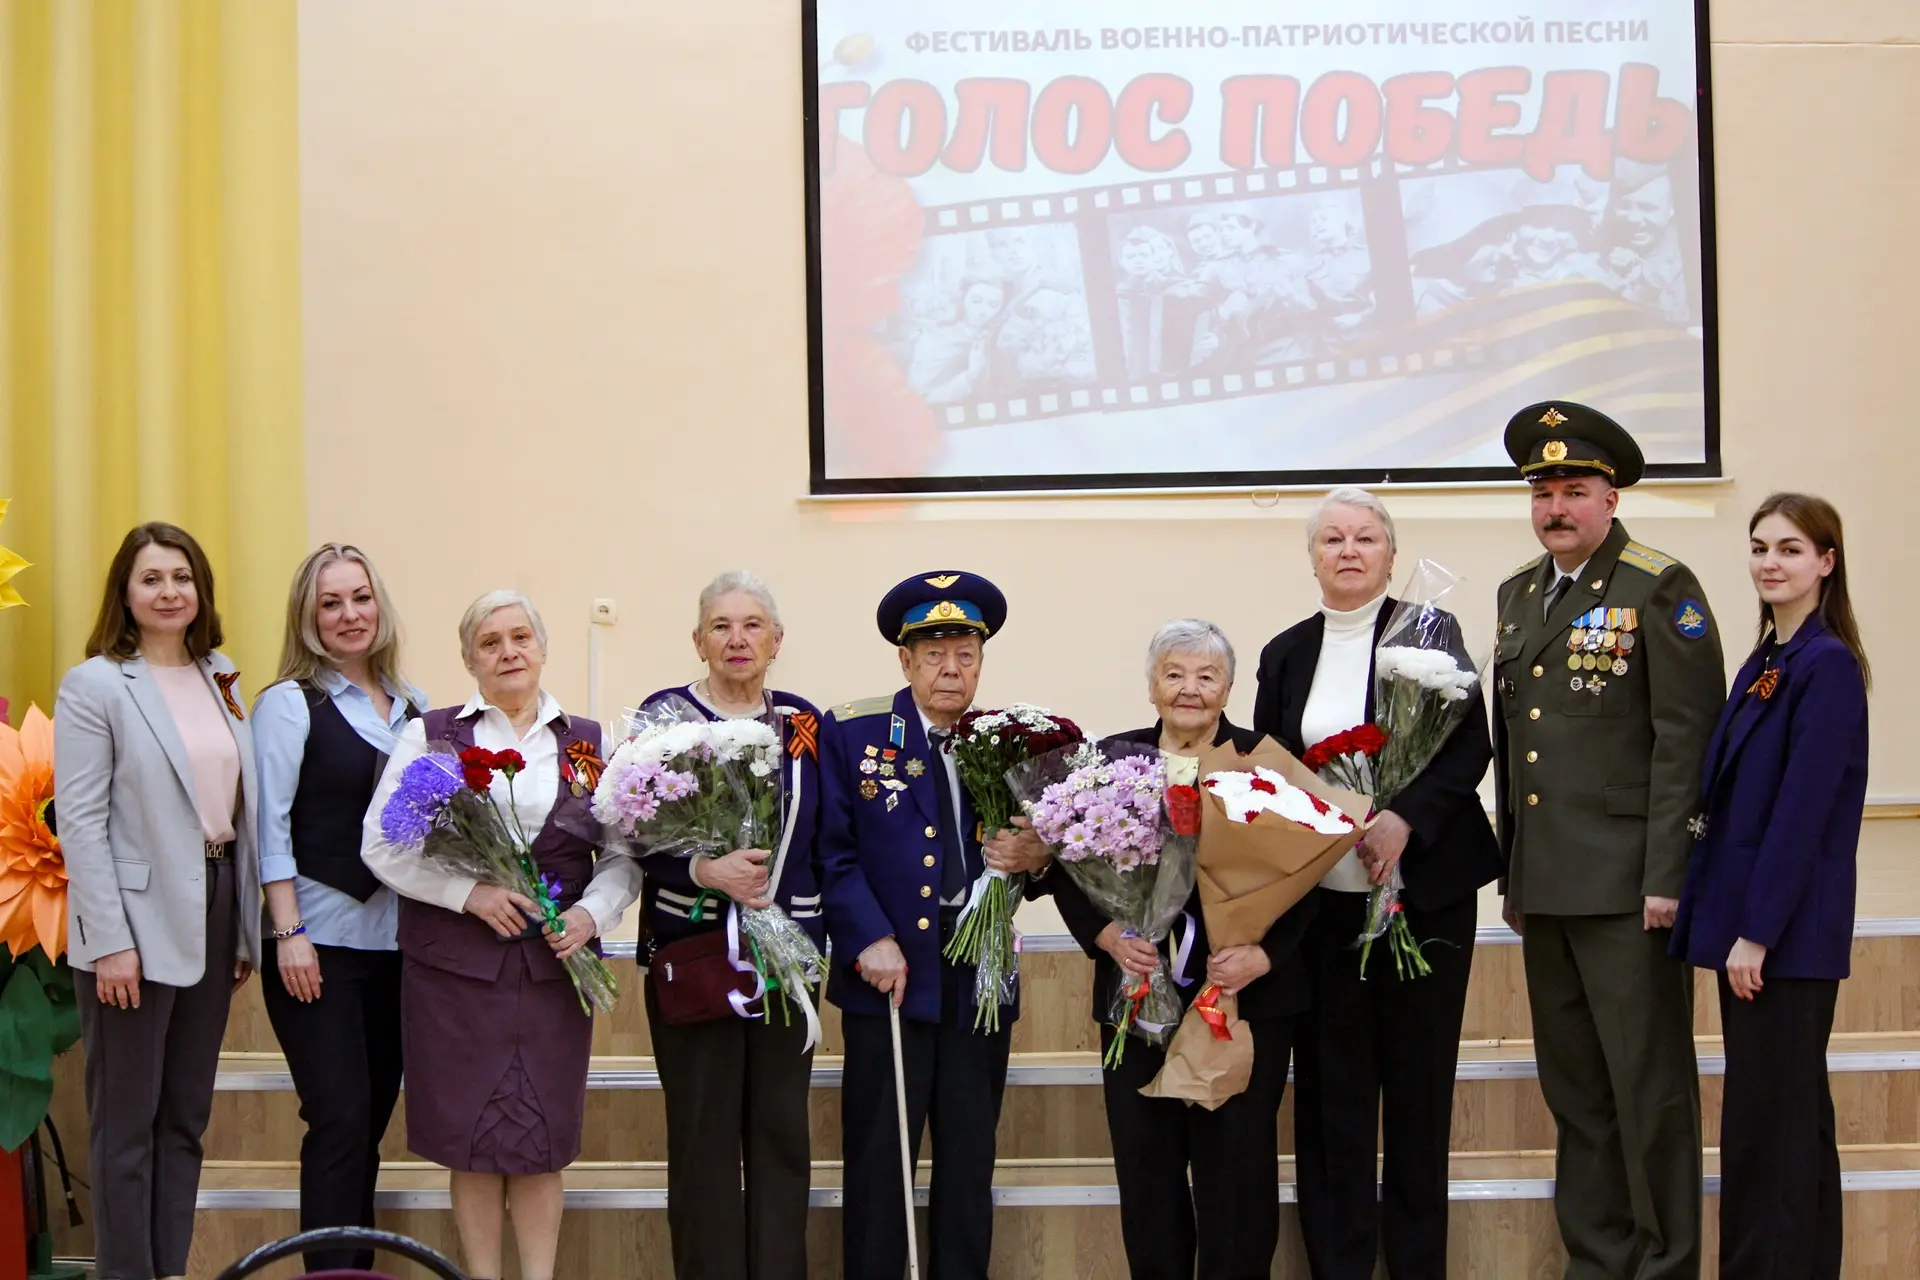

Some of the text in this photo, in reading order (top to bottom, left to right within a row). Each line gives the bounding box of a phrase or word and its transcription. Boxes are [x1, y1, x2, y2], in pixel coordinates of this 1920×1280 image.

[905, 16, 1649, 53] ФЕСТИВАЛЬ ВОЕННО-ПАТРИОТИЧЕСКОЙ ПЕСНИ
[820, 72, 1194, 179] ГОЛОС
